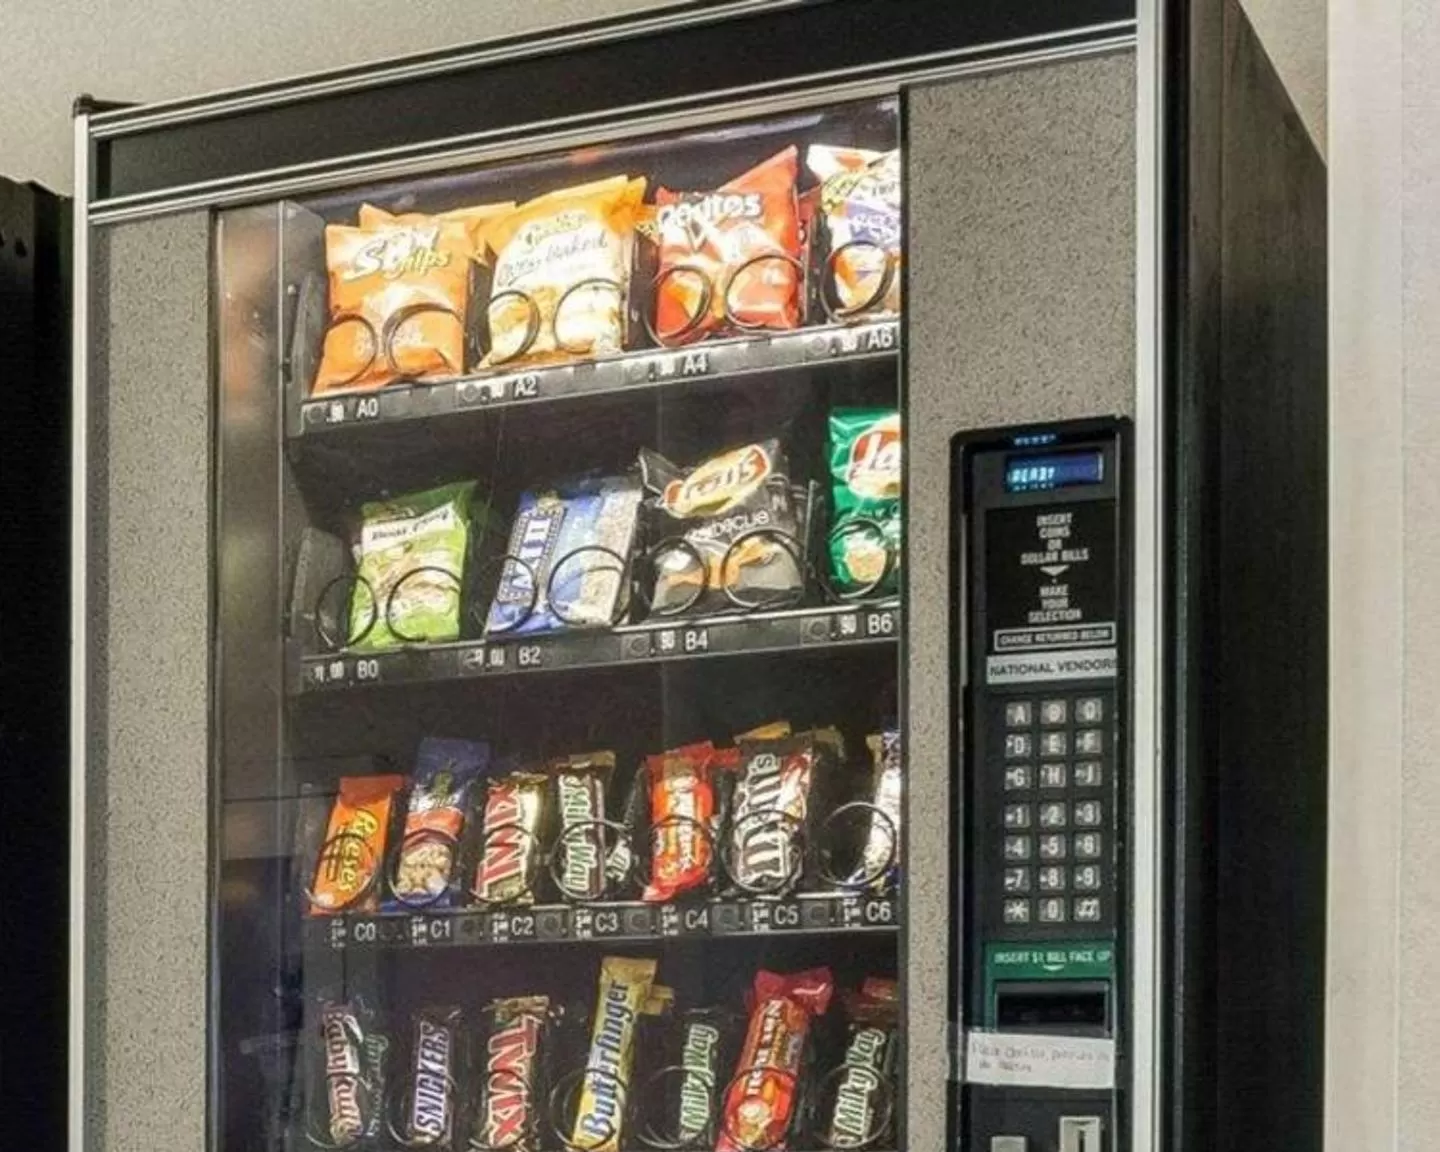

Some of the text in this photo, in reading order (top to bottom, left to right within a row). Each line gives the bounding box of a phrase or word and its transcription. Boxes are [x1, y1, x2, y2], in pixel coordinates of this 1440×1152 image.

[868, 327, 893, 348] A6
[683, 353, 709, 374] A4
[515, 374, 537, 397] A2
[356, 398, 379, 418] A0
[1036, 512, 1073, 527] INSERT
[1020, 548, 1089, 565] DOLLAR BILLS
[1039, 584, 1069, 597] MAKE
[868, 614, 893, 634] B6
[1027, 608, 1083, 623] SELECTION
[685, 632, 709, 651] B4
[1000, 633, 1033, 645] CHANGE
[518, 646, 541, 665] B2
[357, 659, 379, 679] B0
[990, 661, 1054, 677] NATIONAL
[685, 909, 709, 929] C4
[774, 905, 799, 924] C5
[867, 902, 892, 921] C6
[354, 922, 377, 941] C0
[429, 920, 451, 938] C1
[511, 916, 534, 936] C2
[594, 912, 618, 933] C3
[994, 951, 1030, 964] INSERT
[1046, 951, 1067, 963] BILL
[1069, 950, 1093, 962] FACE
[578, 981, 633, 1136] Butterfinger
[414, 1020, 450, 1131] SNICKERS
